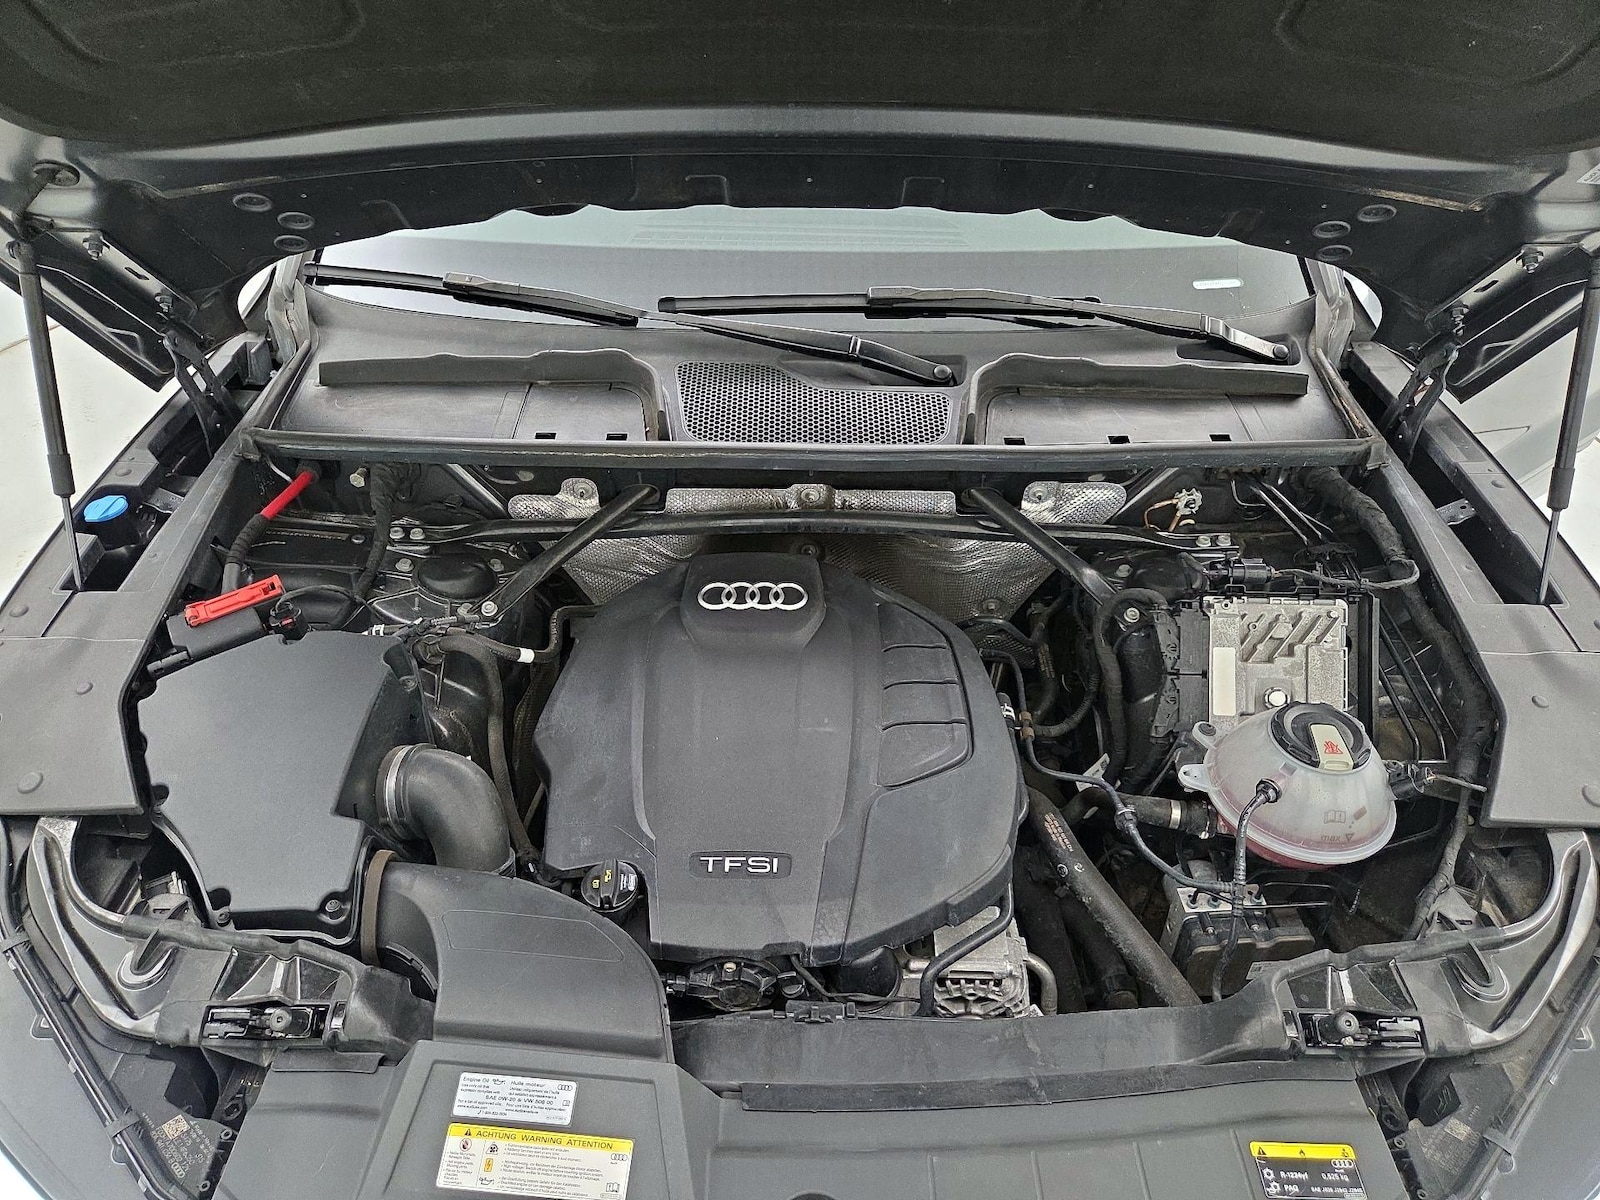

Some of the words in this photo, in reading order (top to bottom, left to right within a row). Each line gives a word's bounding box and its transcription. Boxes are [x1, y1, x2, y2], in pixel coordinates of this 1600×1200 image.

[700, 856, 778, 873] TFSI
[476, 1130, 516, 1140] ACHTUNG
[521, 1134, 562, 1144] WARNING
[566, 1138, 614, 1150] ATTENTION
[1280, 1171, 1308, 1180] R-1234yf
[1340, 1173, 1349, 1182] kg
